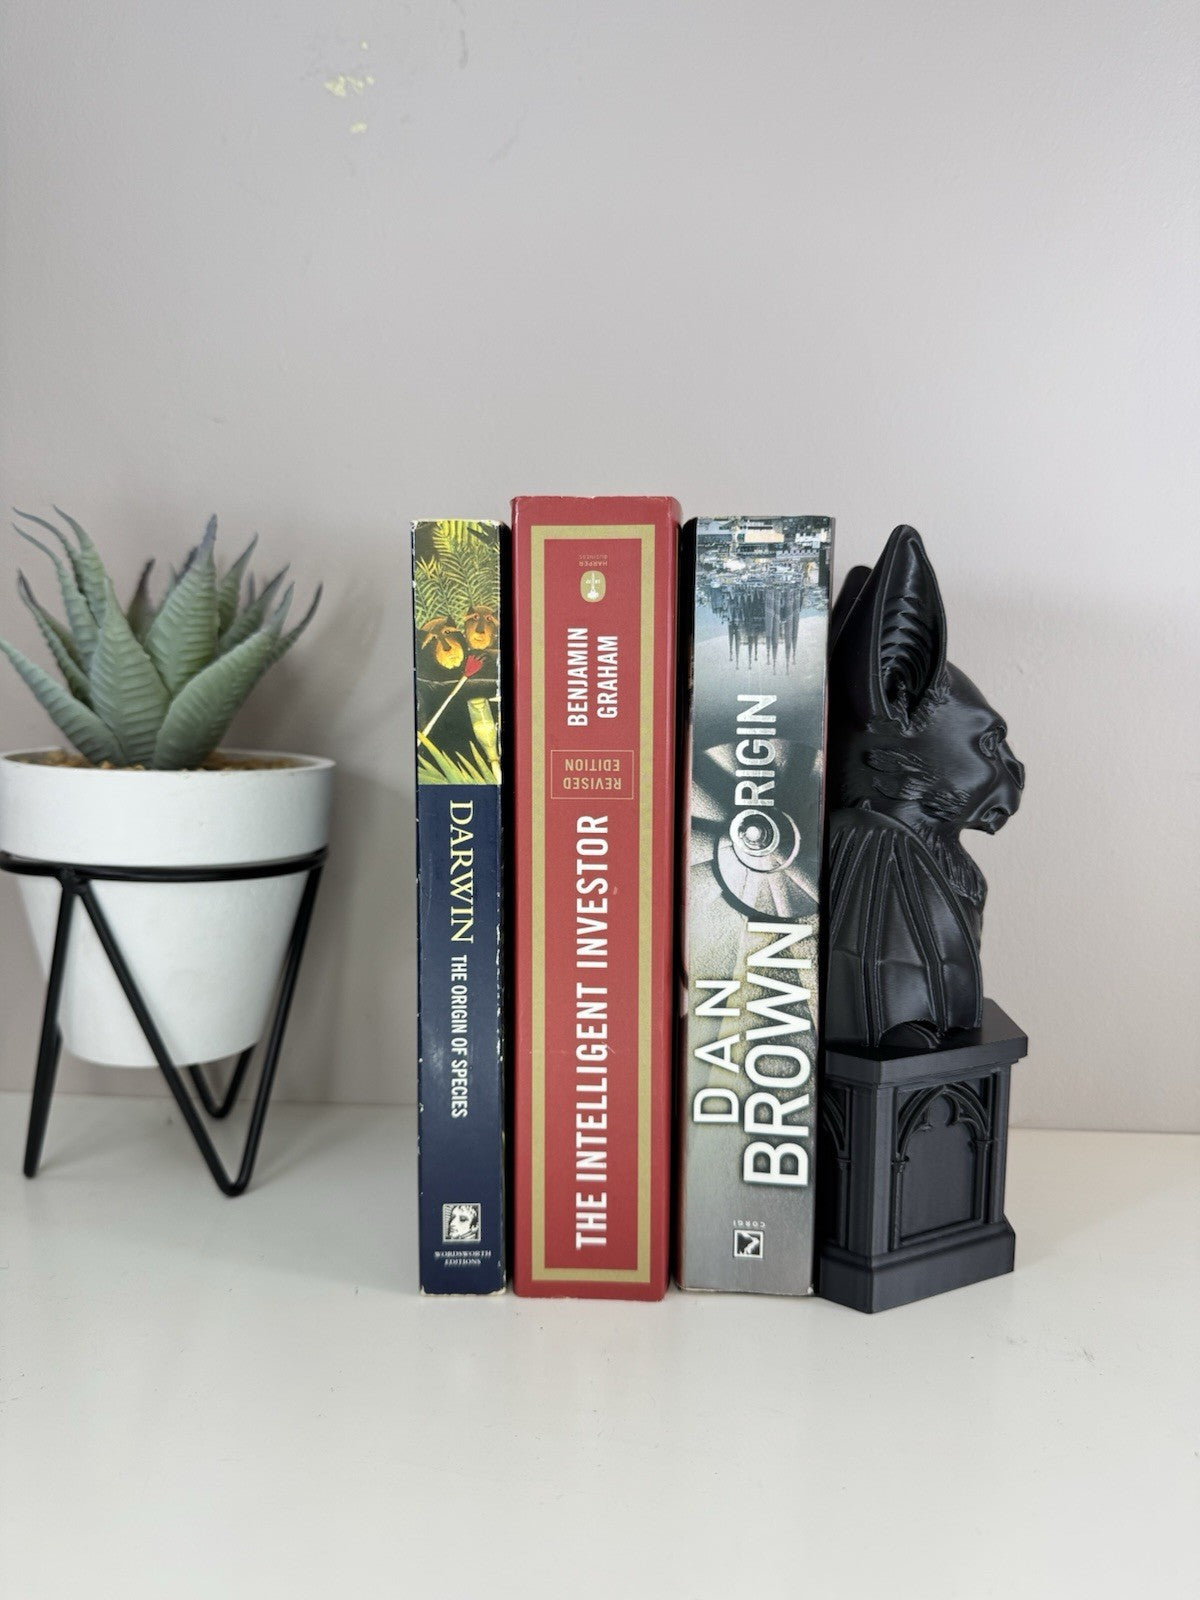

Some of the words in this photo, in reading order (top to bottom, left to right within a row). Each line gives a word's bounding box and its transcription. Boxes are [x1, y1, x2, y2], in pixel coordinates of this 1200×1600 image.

[567, 628, 588, 726] BENJAMIN
[597, 635, 618, 719] GRAHAM
[563, 777, 622, 790] REVISED
[565, 759, 620, 772] EDITION
[729, 695, 780, 857] ORIGIN
[450, 800, 474, 943] DARWIN
[576, 814, 609, 968] INVESTOR
[451, 955, 468, 981] THE
[451, 985, 468, 1033] ORIGIN
[451, 1038, 468, 1056] OF
[451, 1059, 468, 1118] SPECIES
[576, 982, 608, 1182] INTELLIGENT
[693, 979, 741, 1123] DAN
[743, 921, 813, 1186] BROWN
[576, 1192, 608, 1250] THE
